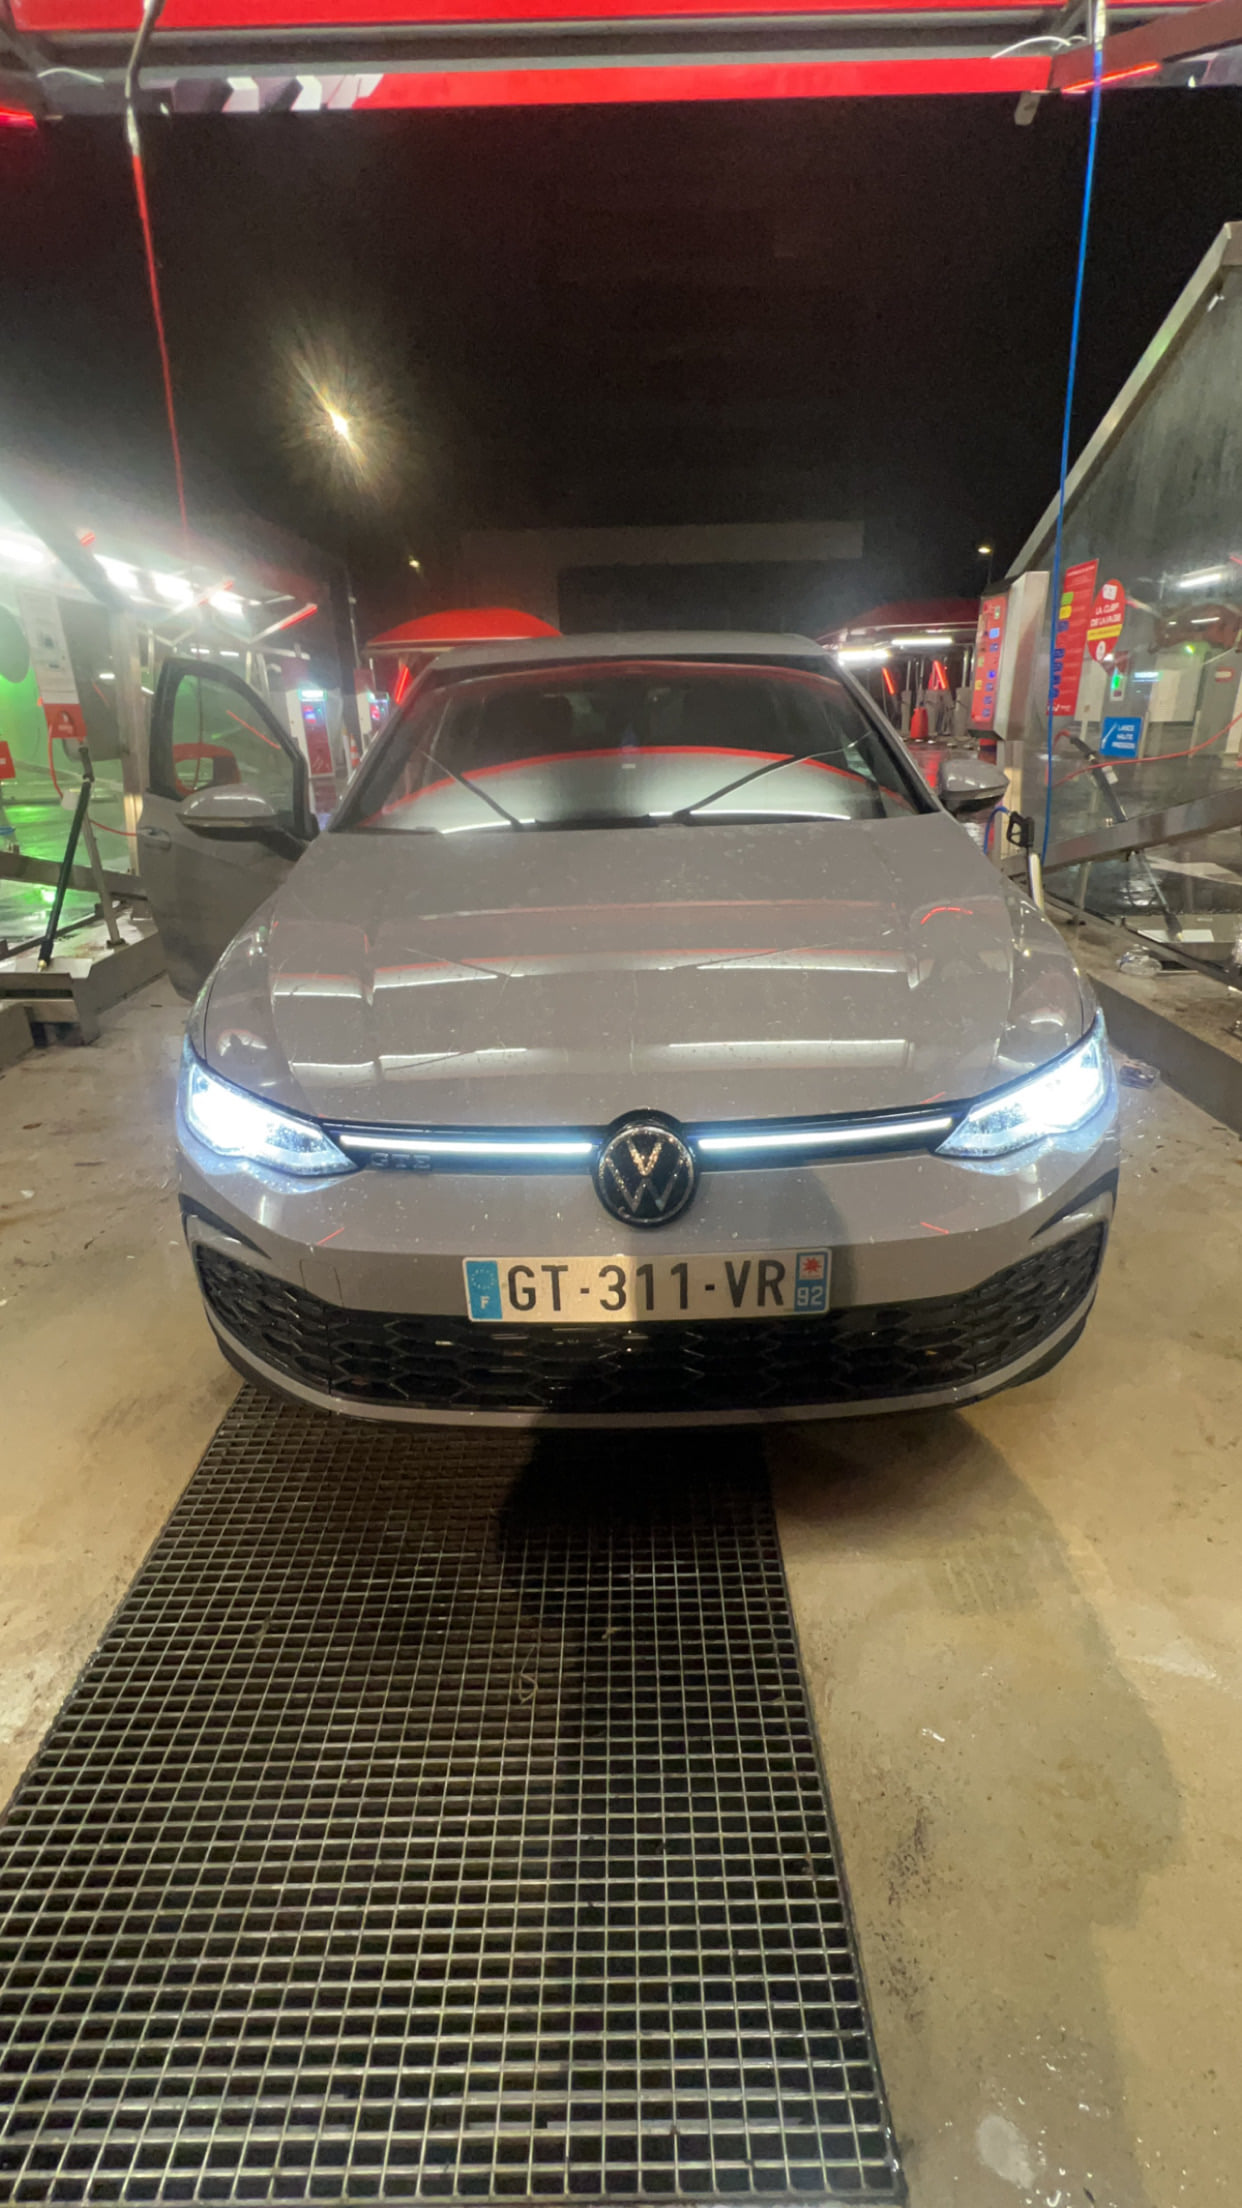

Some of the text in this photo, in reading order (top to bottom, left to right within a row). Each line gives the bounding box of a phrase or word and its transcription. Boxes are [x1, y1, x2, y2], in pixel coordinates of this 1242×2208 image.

[507, 1259, 786, 1312] GT-311-VR
[796, 1285, 824, 1307] 92
[479, 1295, 490, 1310] F
